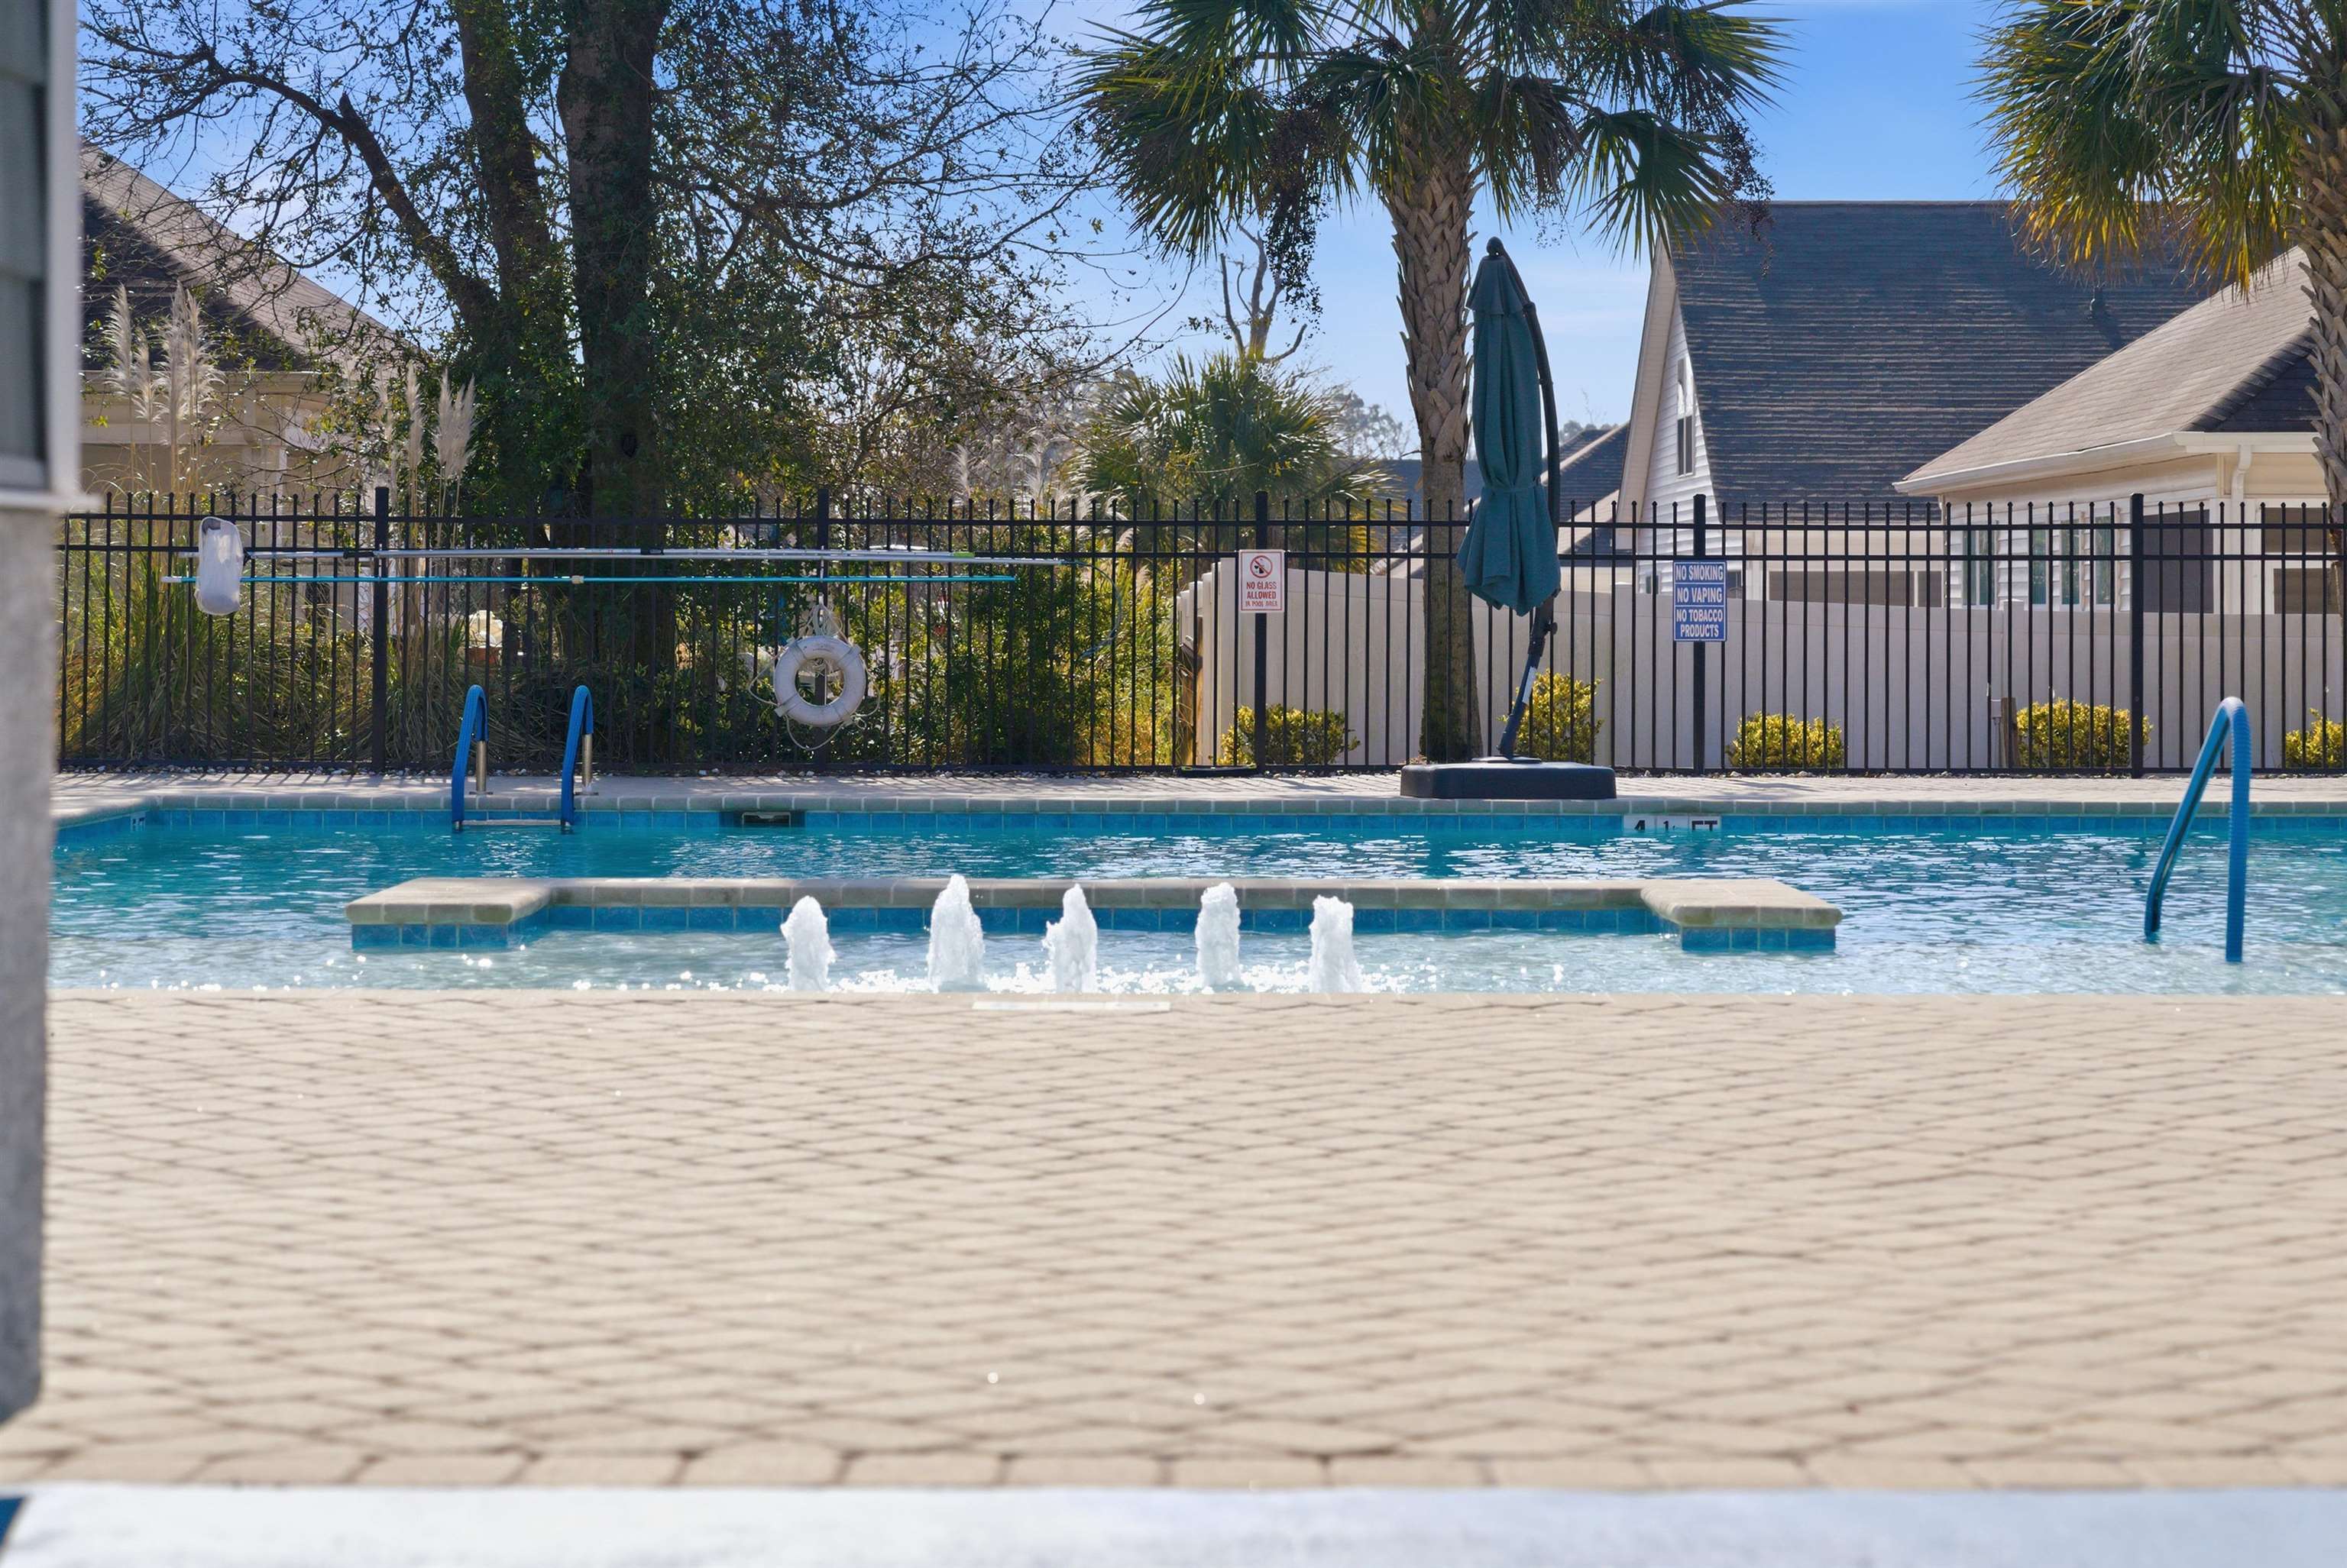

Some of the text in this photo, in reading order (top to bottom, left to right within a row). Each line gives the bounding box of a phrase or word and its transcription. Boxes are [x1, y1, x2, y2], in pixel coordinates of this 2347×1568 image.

[1675, 564, 1724, 580] NO SMOKING
[1246, 581, 1277, 590] NO GLASS
[1247, 591, 1277, 600] ALLOWED
[1676, 587, 1723, 603] NO VAPING
[1676, 609, 1723, 622] NO TOBACCO
[1680, 624, 1719, 638] PRODUCTS
